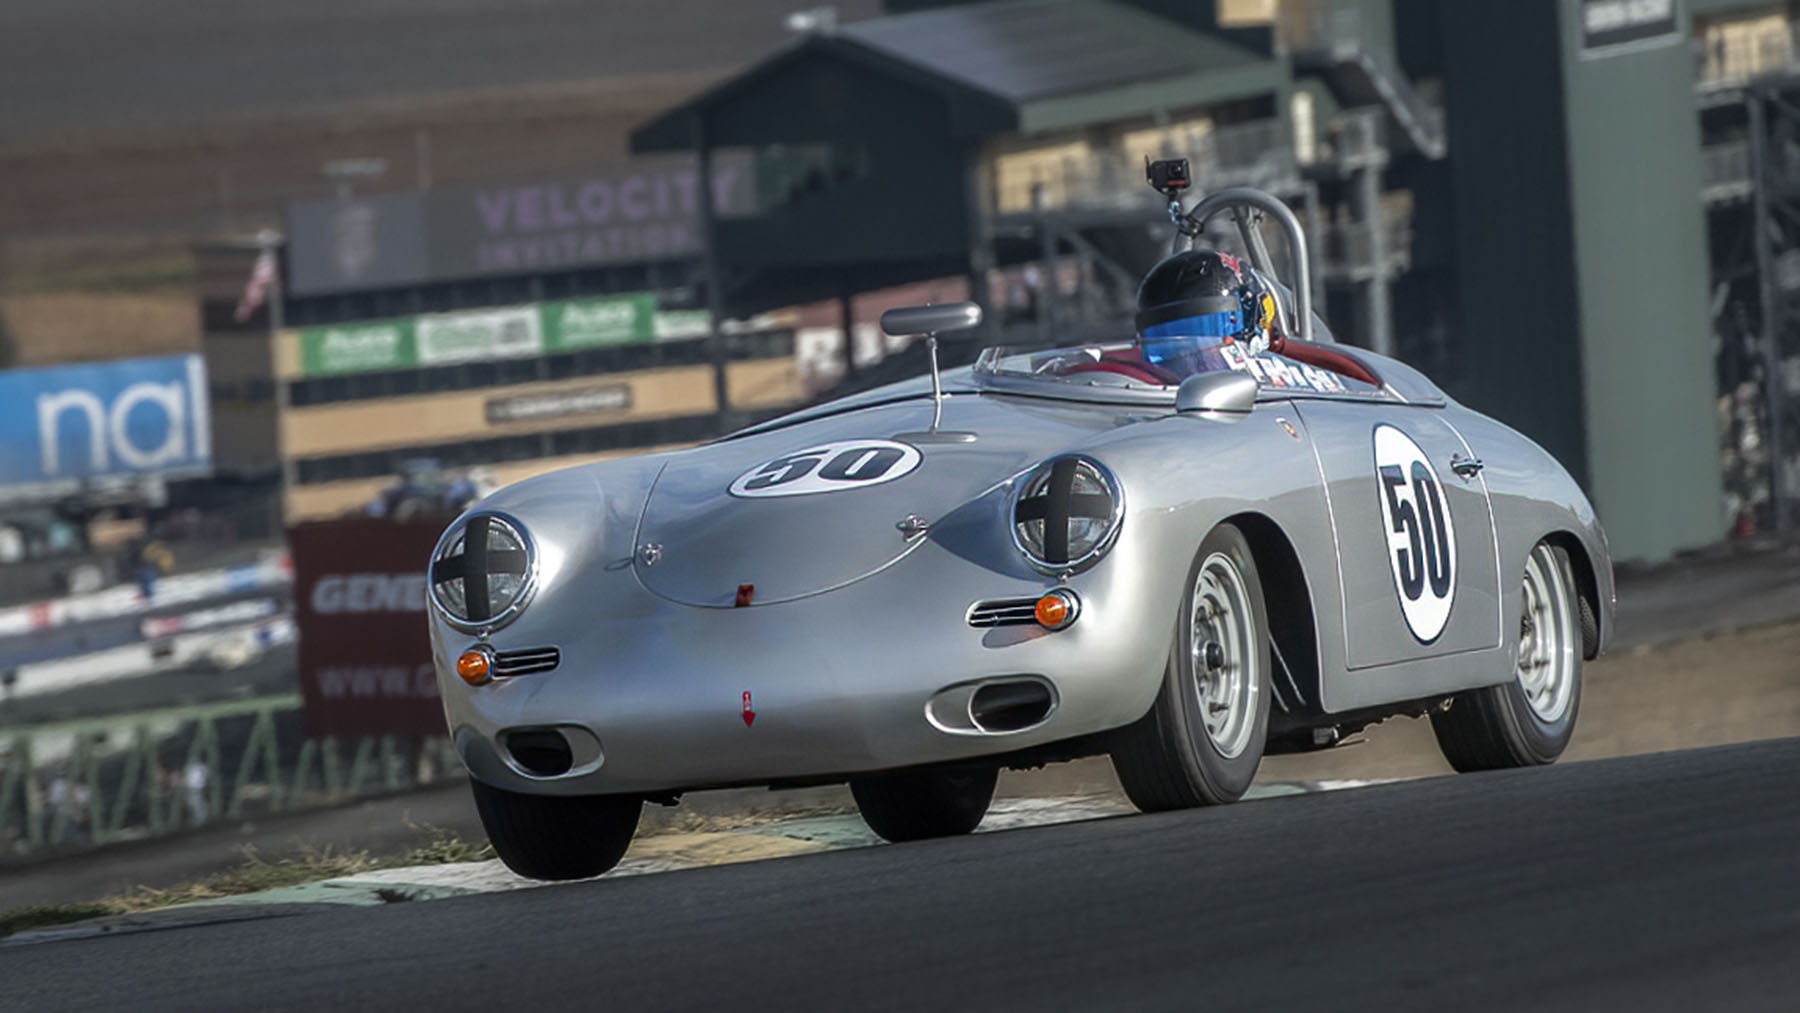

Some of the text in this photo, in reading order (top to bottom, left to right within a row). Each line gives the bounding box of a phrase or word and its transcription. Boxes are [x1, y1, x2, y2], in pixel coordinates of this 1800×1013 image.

[476, 171, 736, 231] VELOCITY
[744, 447, 905, 490] 50
[1379, 460, 1452, 601] 50
